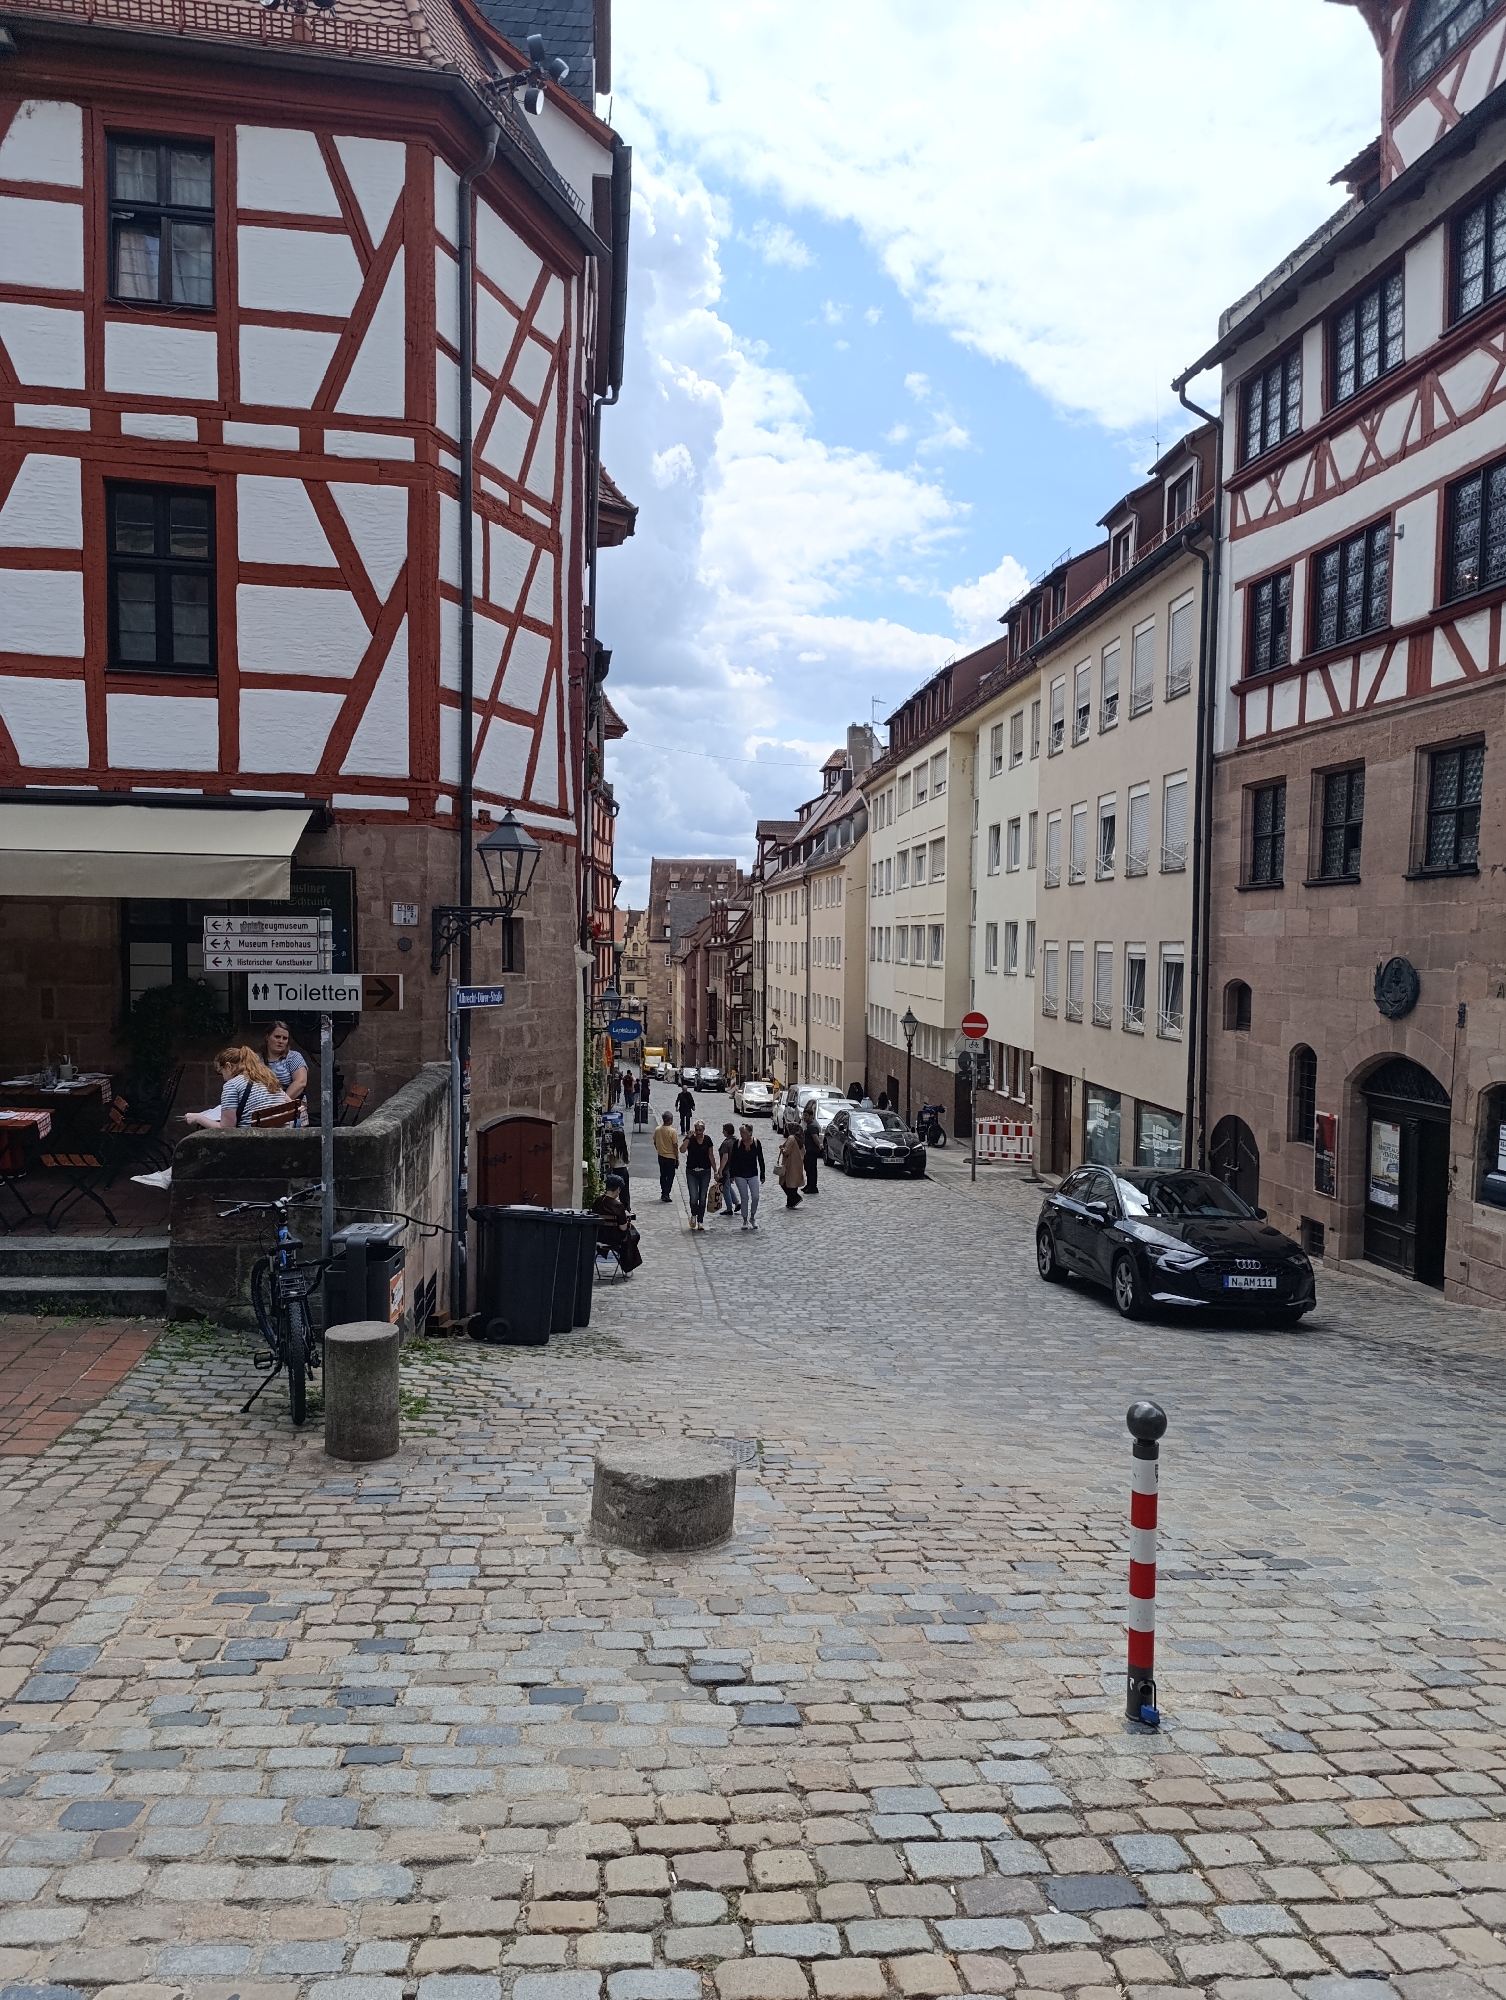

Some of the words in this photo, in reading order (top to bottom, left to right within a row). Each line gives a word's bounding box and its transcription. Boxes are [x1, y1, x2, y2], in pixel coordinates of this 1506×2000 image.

[286, 896, 332, 907] Schranke
[238, 939, 268, 948] Museum
[271, 939, 311, 949] Fembohaus
[236, 958, 273, 966] Historischer
[275, 958, 313, 967] Kunstbunker
[274, 983, 359, 1001] Toiletten
[1232, 1278, 1238, 1286] N
